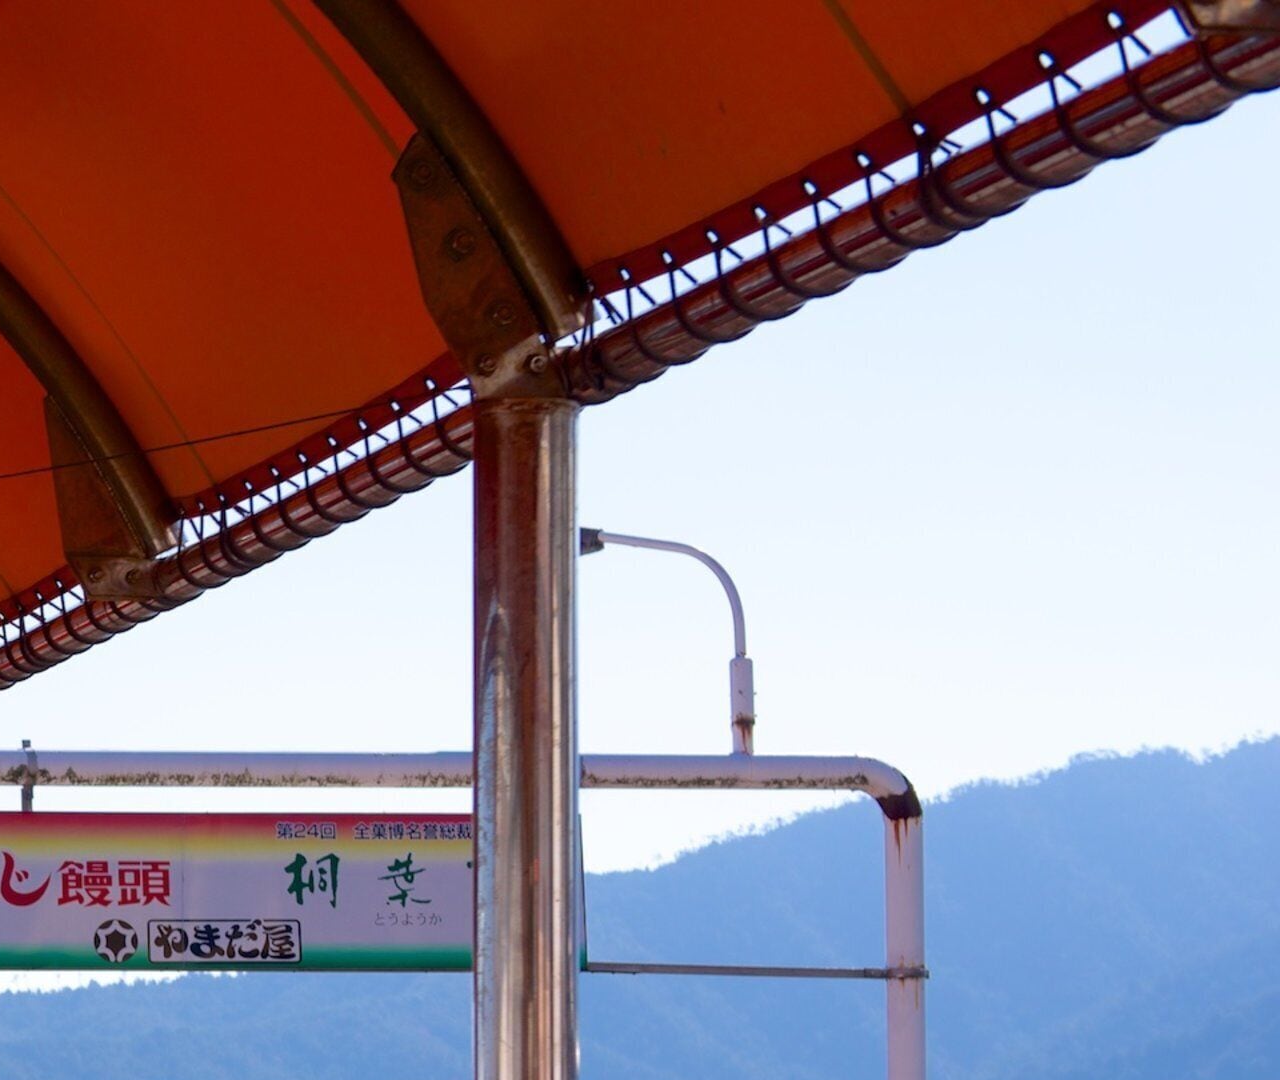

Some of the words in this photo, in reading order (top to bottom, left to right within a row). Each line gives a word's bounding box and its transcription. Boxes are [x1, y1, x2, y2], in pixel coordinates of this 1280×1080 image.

[276, 822, 336, 840] 第24回
[353, 822, 473, 840] 全菓博名誉総裁
[283, 852, 473, 908] 桐葉
[373, 912, 443, 926] とうようか
[153, 918, 297, 960] やまだ屋
